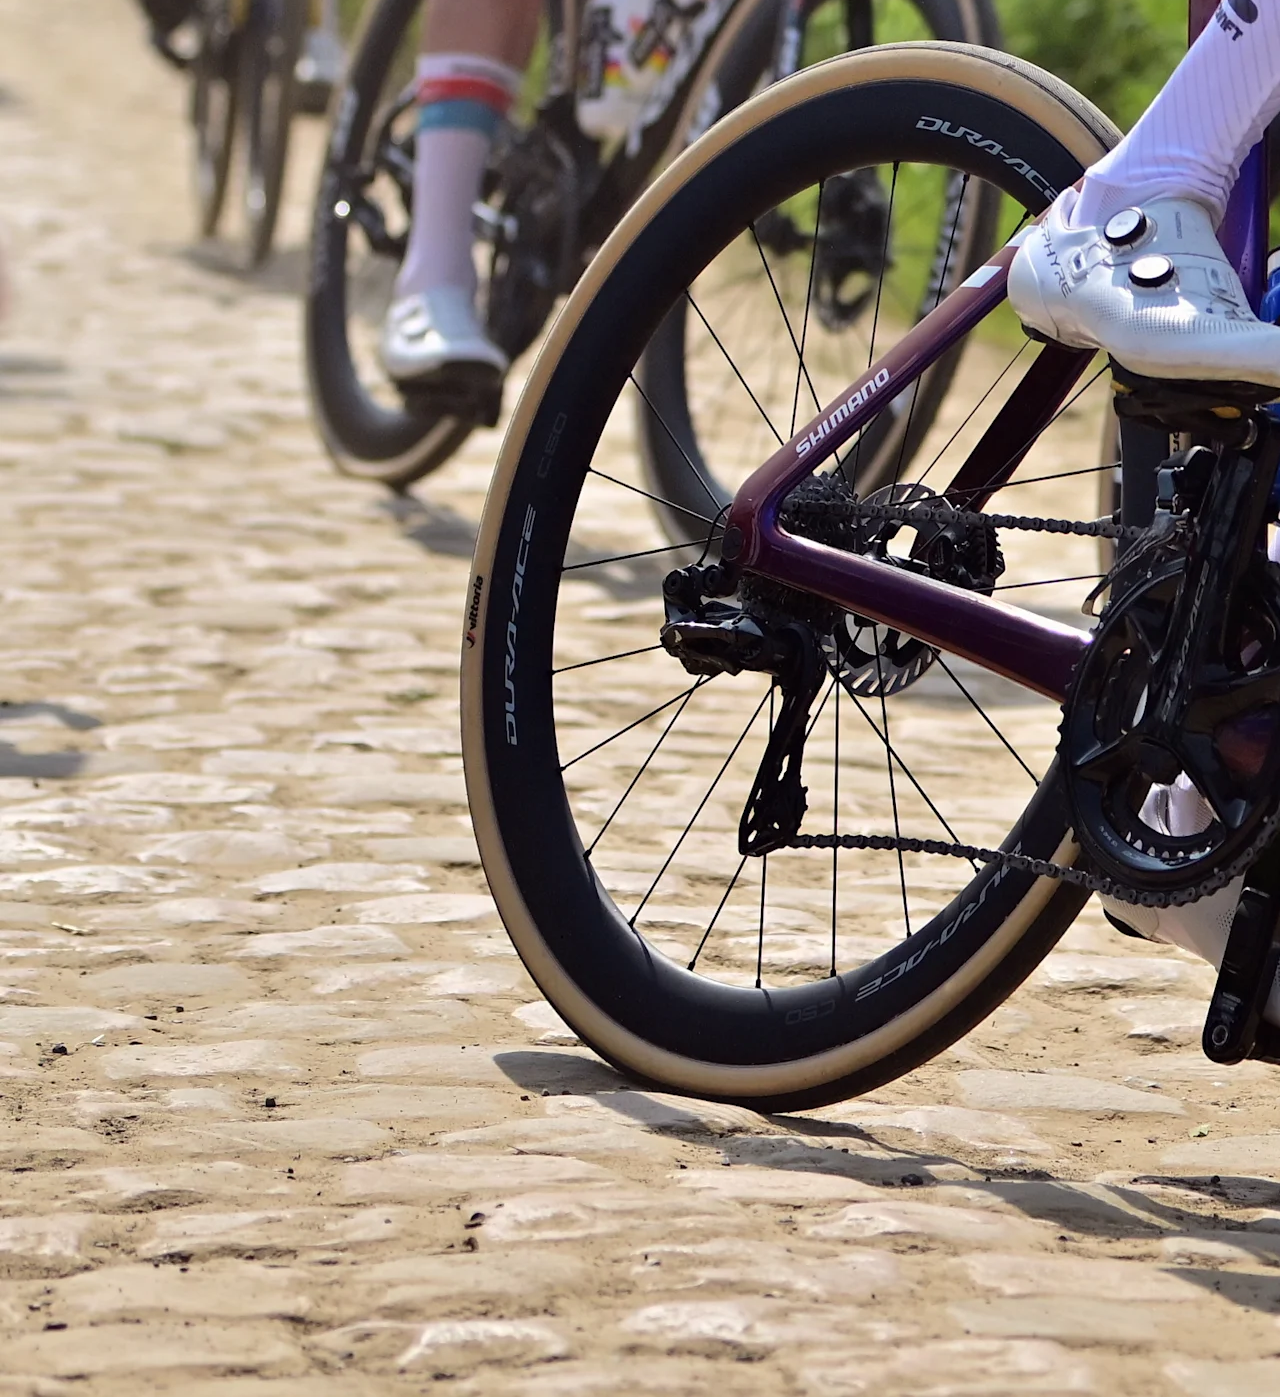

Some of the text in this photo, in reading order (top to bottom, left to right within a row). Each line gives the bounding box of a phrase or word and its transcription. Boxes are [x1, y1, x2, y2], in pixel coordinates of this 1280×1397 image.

[795, 368, 890, 459] SHIMANO
[469, 574, 484, 633] vittoria
[505, 503, 538, 747] DURA-ACE
